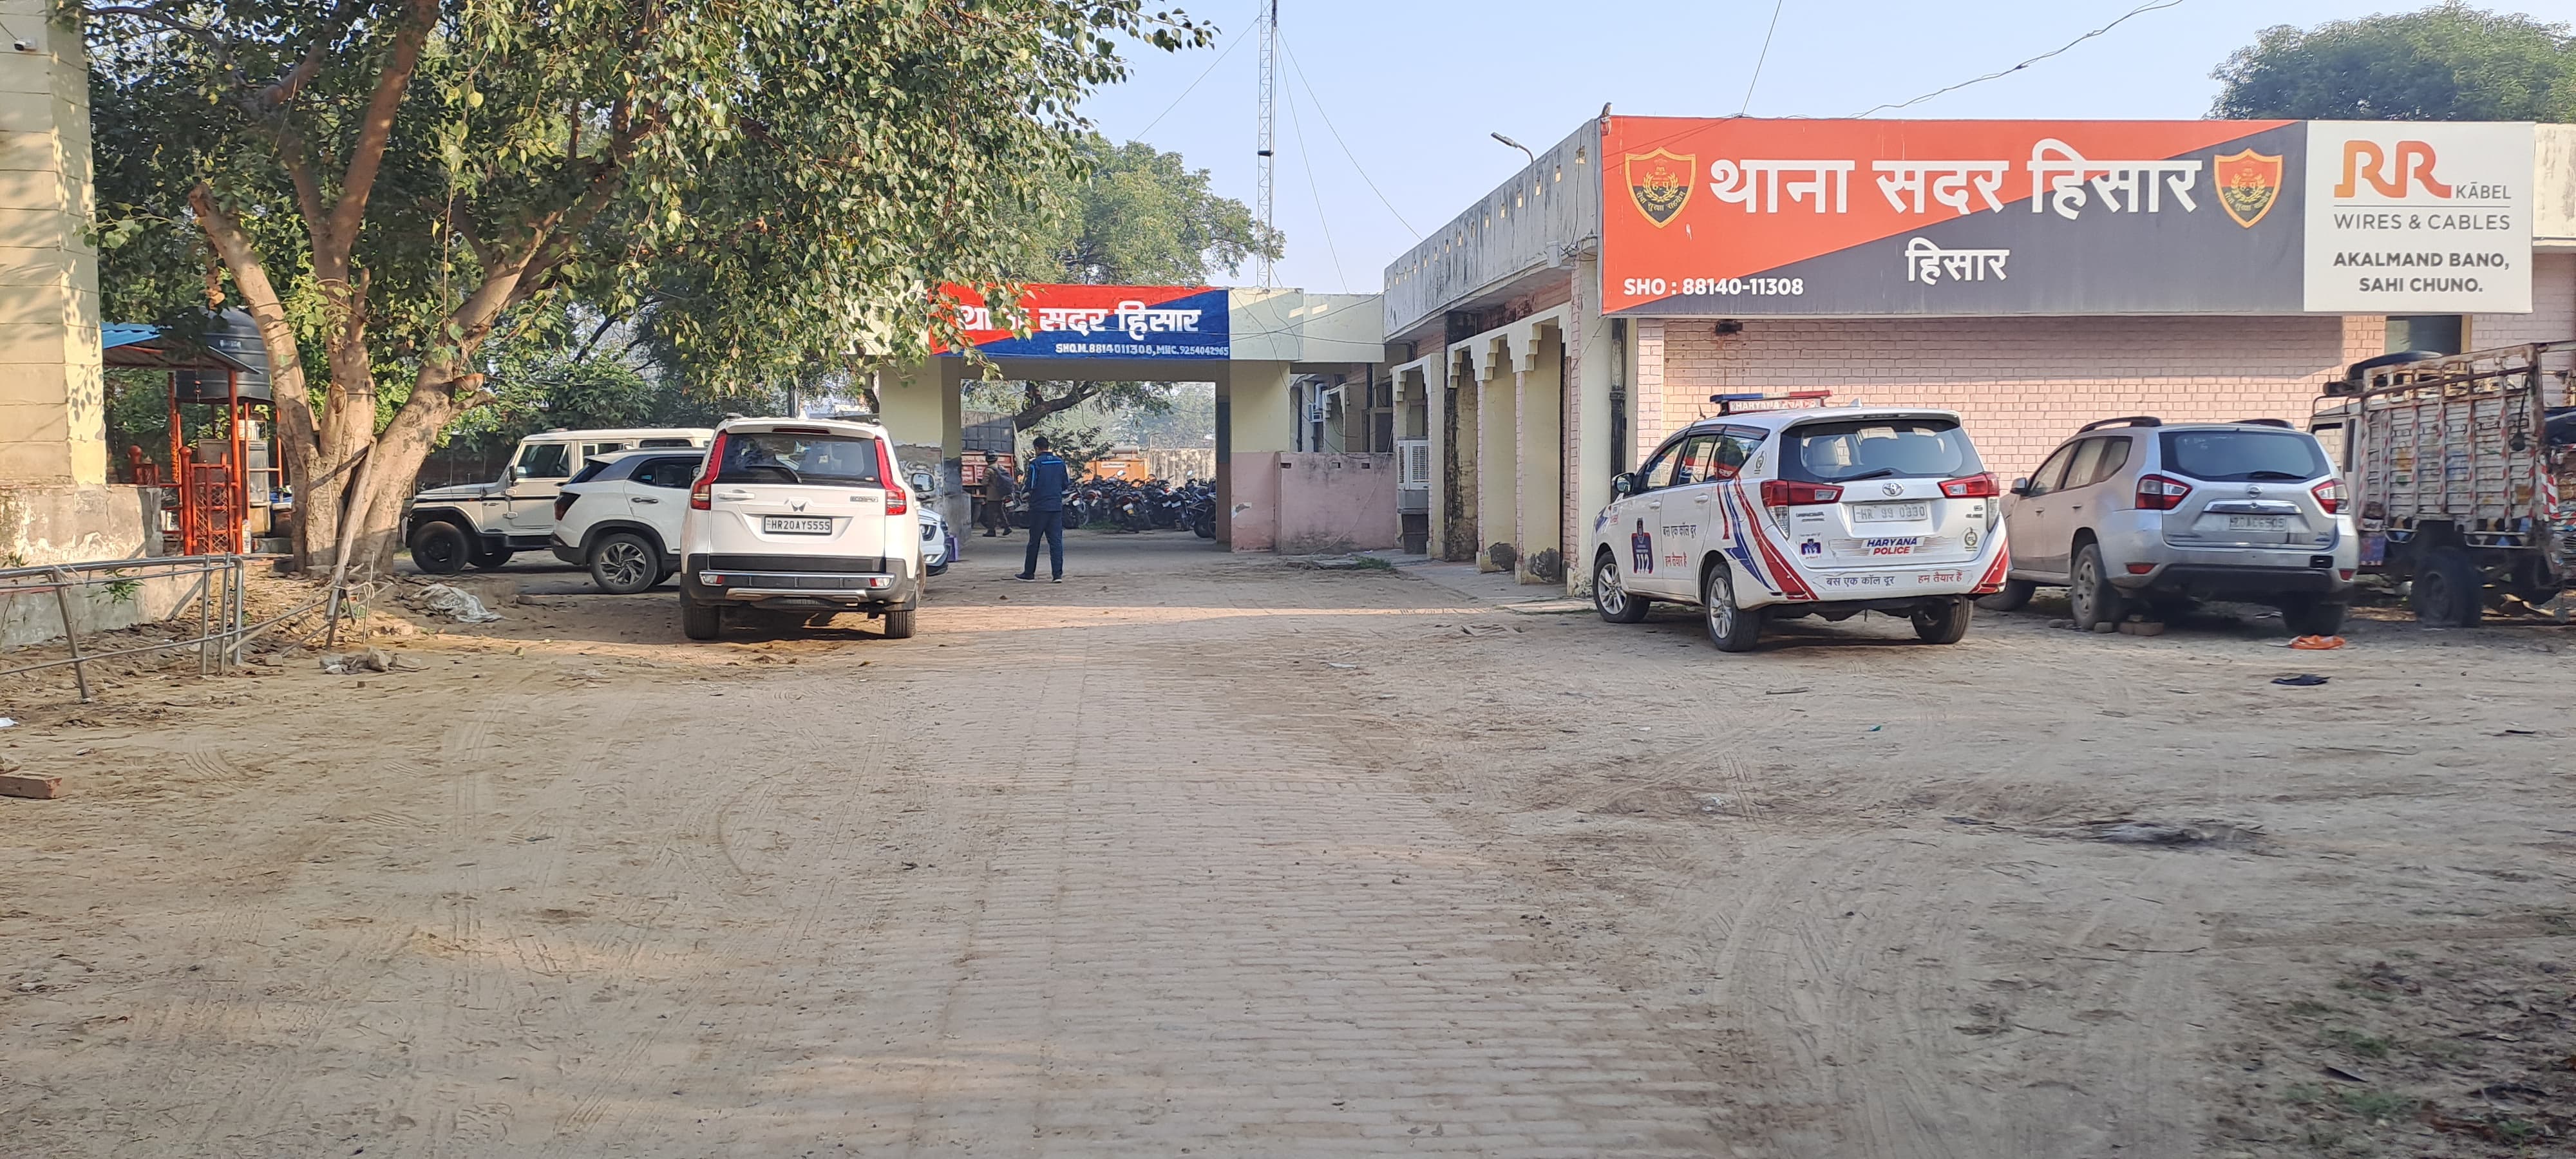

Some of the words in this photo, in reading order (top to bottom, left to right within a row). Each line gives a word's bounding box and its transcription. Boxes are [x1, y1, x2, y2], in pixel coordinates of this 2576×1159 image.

[2334, 140, 2452, 198] RR
[1709, 159, 1855, 213] थाना
[1871, 160, 2009, 214] सदर
[2026, 138, 2202, 220] हिसार
[2334, 214, 2401, 230] WIRES
[2408, 214, 2421, 230] &
[2427, 214, 2511, 231] CABLES
[1904, 237, 2010, 285] हिसार
[2333, 252, 2443, 267] AKALMAND
[2448, 252, 2510, 270] BANO,
[1624, 278, 1666, 296] SHO
[1681, 278, 1804, 296] 88140-11308
[2359, 278, 2404, 292] SAHI
[2410, 278, 2484, 292] CHUNO.
[1039, 308, 1109, 337] सदर
[1114, 301, 1202, 341] हिसार
[772, 520, 830, 531] HR20AY5555
[1867, 537, 1917, 547] HARYANA
[1873, 547, 1911, 555] POLICE
[1843, 577, 1859, 587] एक
[1861, 574, 1881, 585] कॉल
[1883, 576, 1895, 587] दूर
[1917, 574, 1930, 583] हम
[1933, 571, 1955, 583] तैयार
